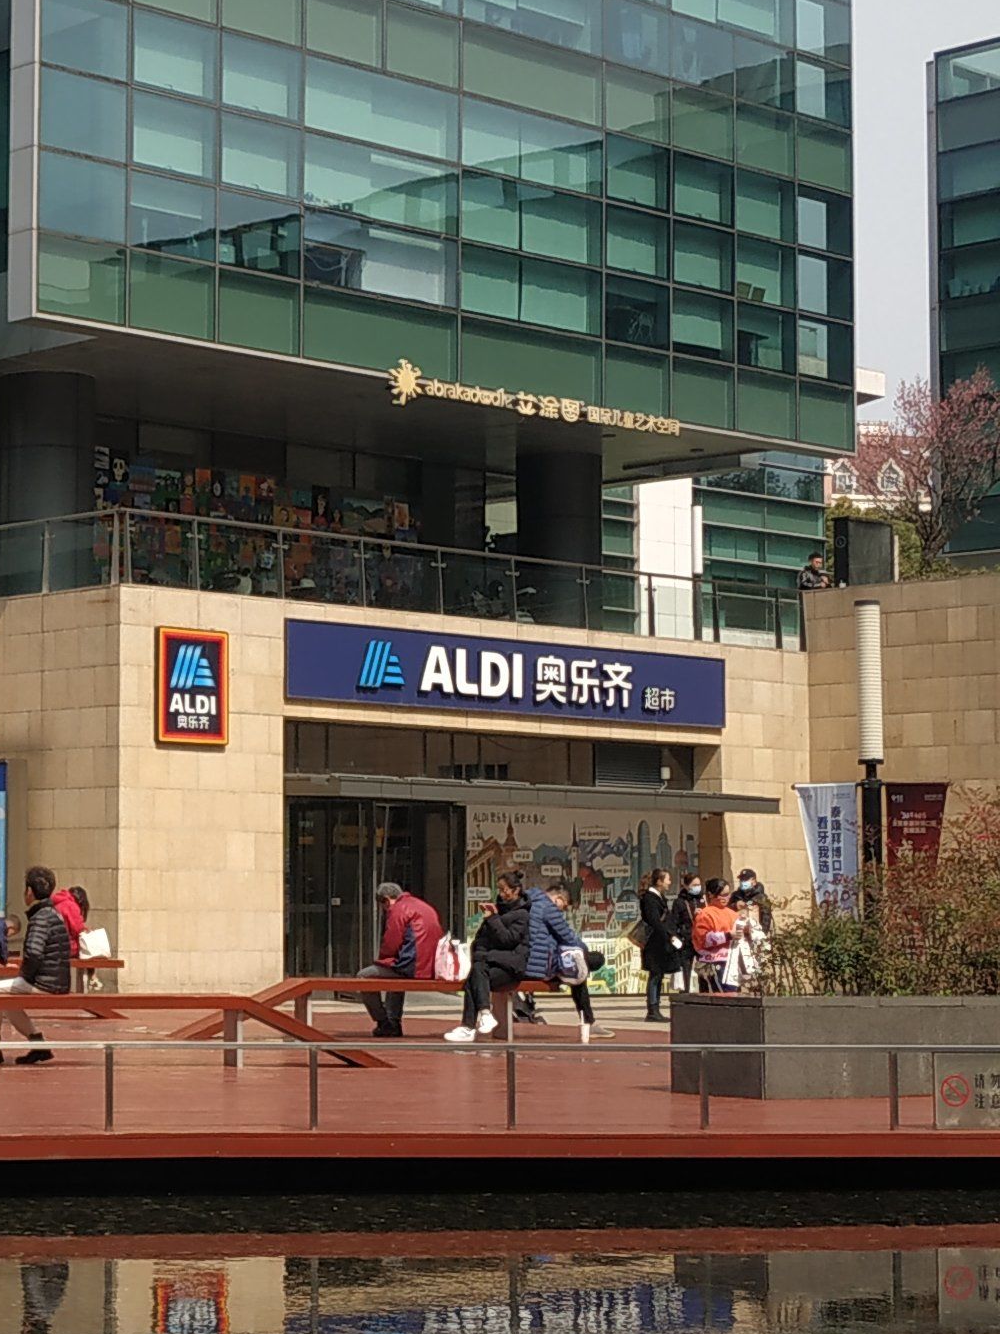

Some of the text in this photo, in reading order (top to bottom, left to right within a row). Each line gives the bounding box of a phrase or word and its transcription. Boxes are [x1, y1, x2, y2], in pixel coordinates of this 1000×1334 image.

[425, 379, 516, 410] abrakadoodle
[420, 645, 676, 711] ALDI 奥乐齐 超市
[169, 692, 217, 715] ALDI
[177, 715, 209, 730] 奥乐齐
